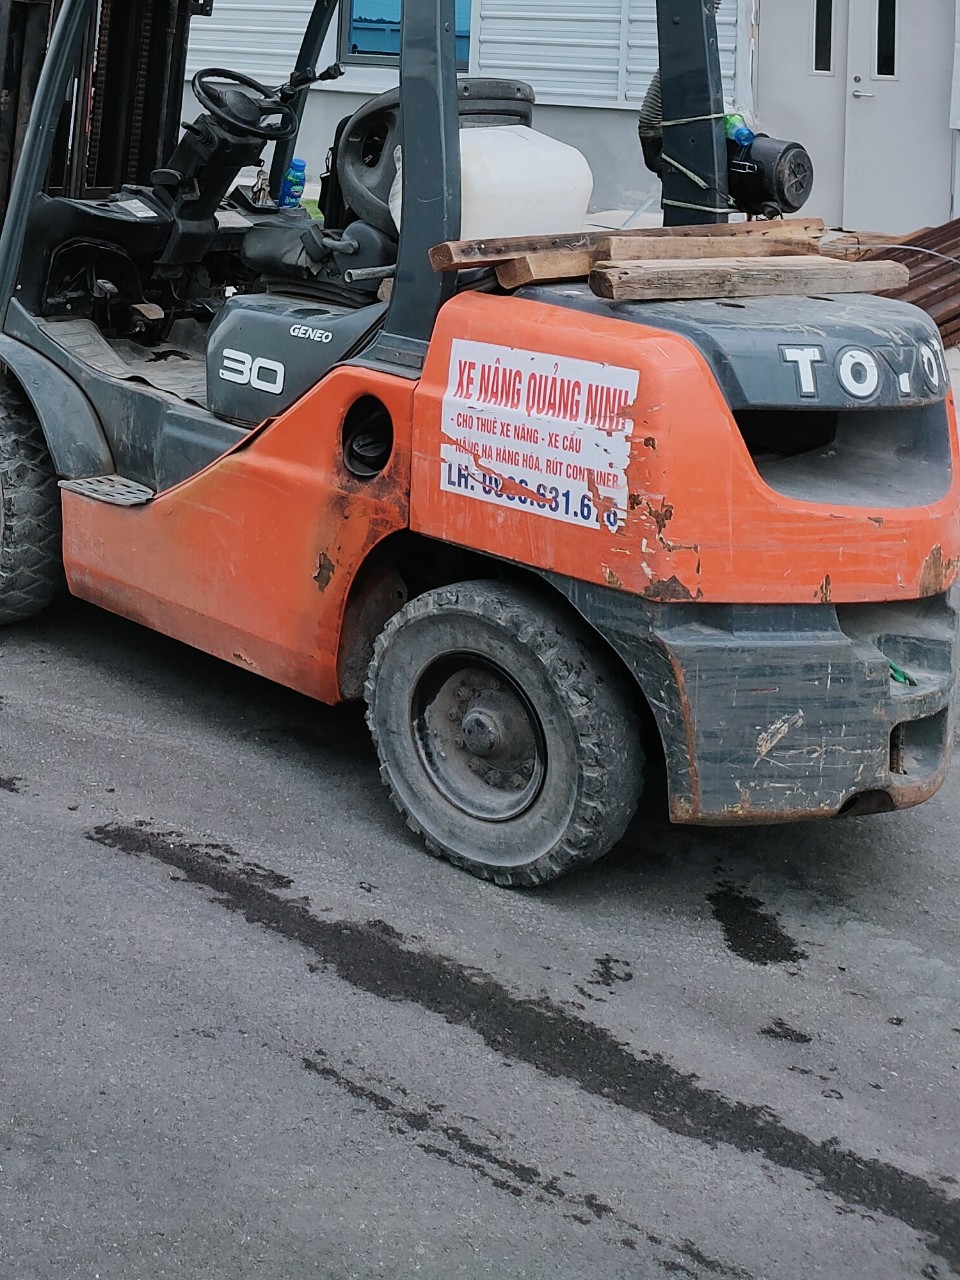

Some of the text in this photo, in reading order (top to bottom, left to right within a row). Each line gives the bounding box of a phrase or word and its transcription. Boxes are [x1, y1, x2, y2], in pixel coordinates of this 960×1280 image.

[289, 324, 332, 344] GENEO
[219, 348, 285, 395] 30
[453, 359, 476, 399] XE
[476, 357, 523, 410] NÂNG
[526, 362, 582, 423] QUẢNG
[456, 412, 474, 430] CHO
[476, 416, 497, 435] THUÊ
[500, 421, 511, 438] XE
[513, 423, 539, 444] NÂNG
[548, 432, 560, 449] XE
[562, 431, 581, 454] CẨU
[482, 443, 493, 464] HẠ
[496, 445, 520, 466] HÀNG
[545, 457, 563, 477] RÚT
